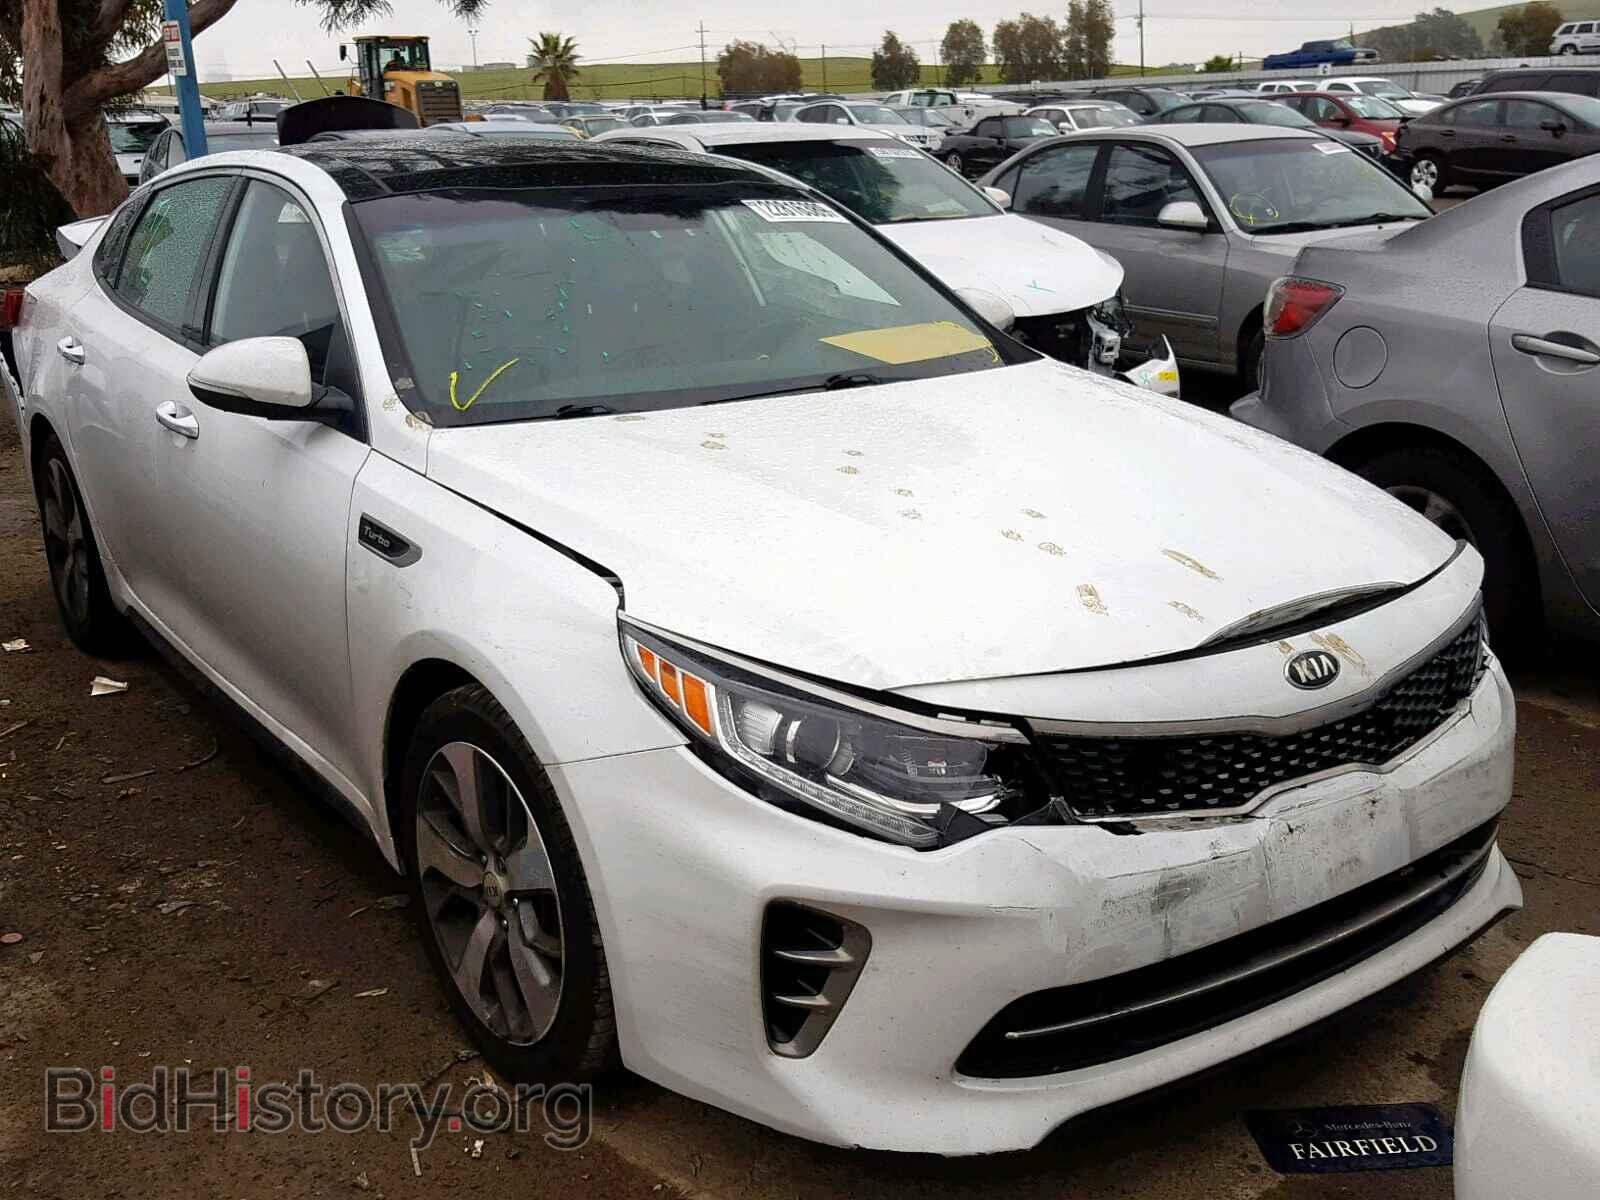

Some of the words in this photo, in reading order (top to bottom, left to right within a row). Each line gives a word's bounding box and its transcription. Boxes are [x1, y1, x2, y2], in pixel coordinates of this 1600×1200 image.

[364, 526, 390, 548] Turbo
[1291, 655, 1337, 683] KIA
[1325, 1120, 1412, 1132] Mercedes-Benz
[1289, 1135, 1438, 1160] FAIRFIELD
